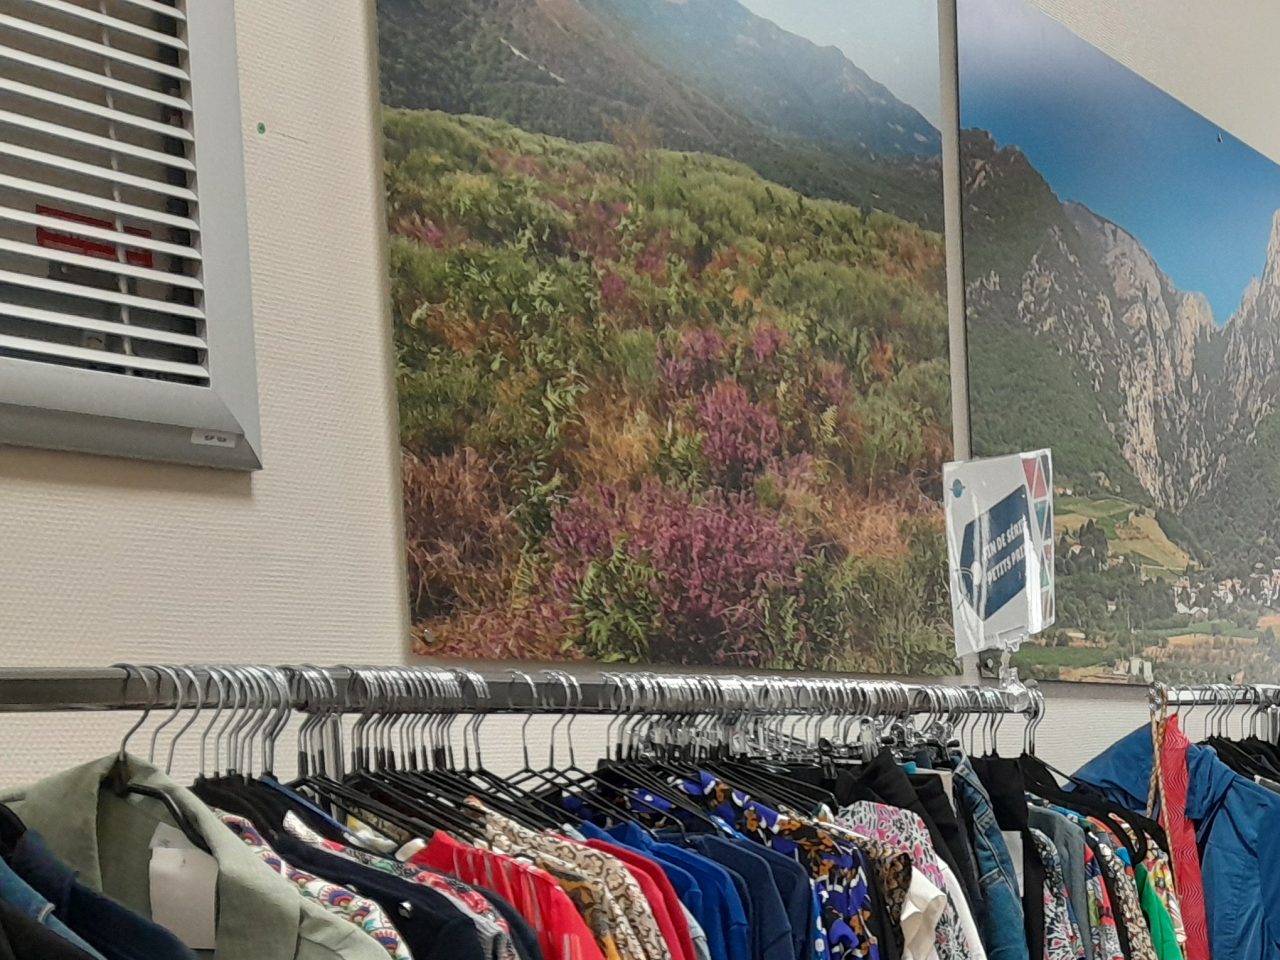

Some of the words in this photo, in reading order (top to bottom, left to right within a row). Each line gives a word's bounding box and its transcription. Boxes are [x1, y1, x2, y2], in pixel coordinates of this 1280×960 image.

[983, 540, 996, 562] FIN
[996, 533, 1007, 551] DE
[987, 556, 1012, 585] PETITS
[1011, 544, 1028, 566] PRI
